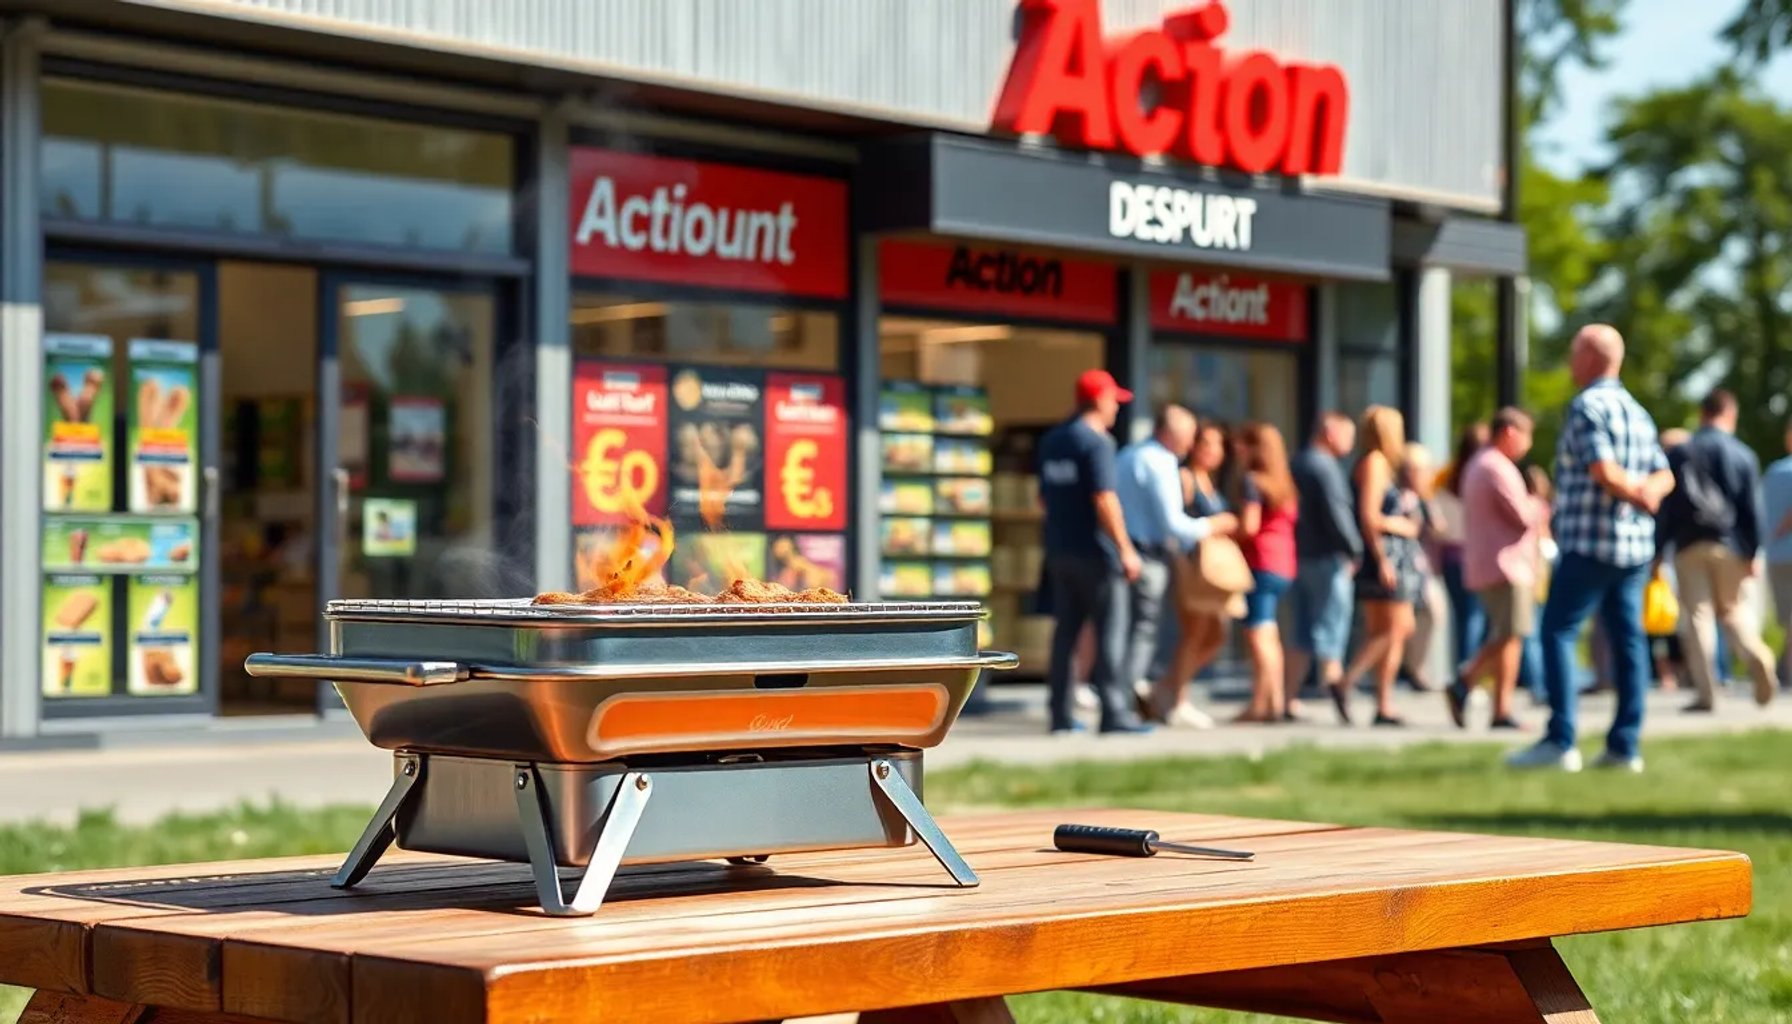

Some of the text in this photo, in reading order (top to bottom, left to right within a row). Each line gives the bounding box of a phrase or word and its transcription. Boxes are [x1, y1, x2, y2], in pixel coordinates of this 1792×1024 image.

[576, 176, 796, 265] Actiount
[1109, 180, 1257, 250] DESPURT
[945, 246, 1064, 297] Action
